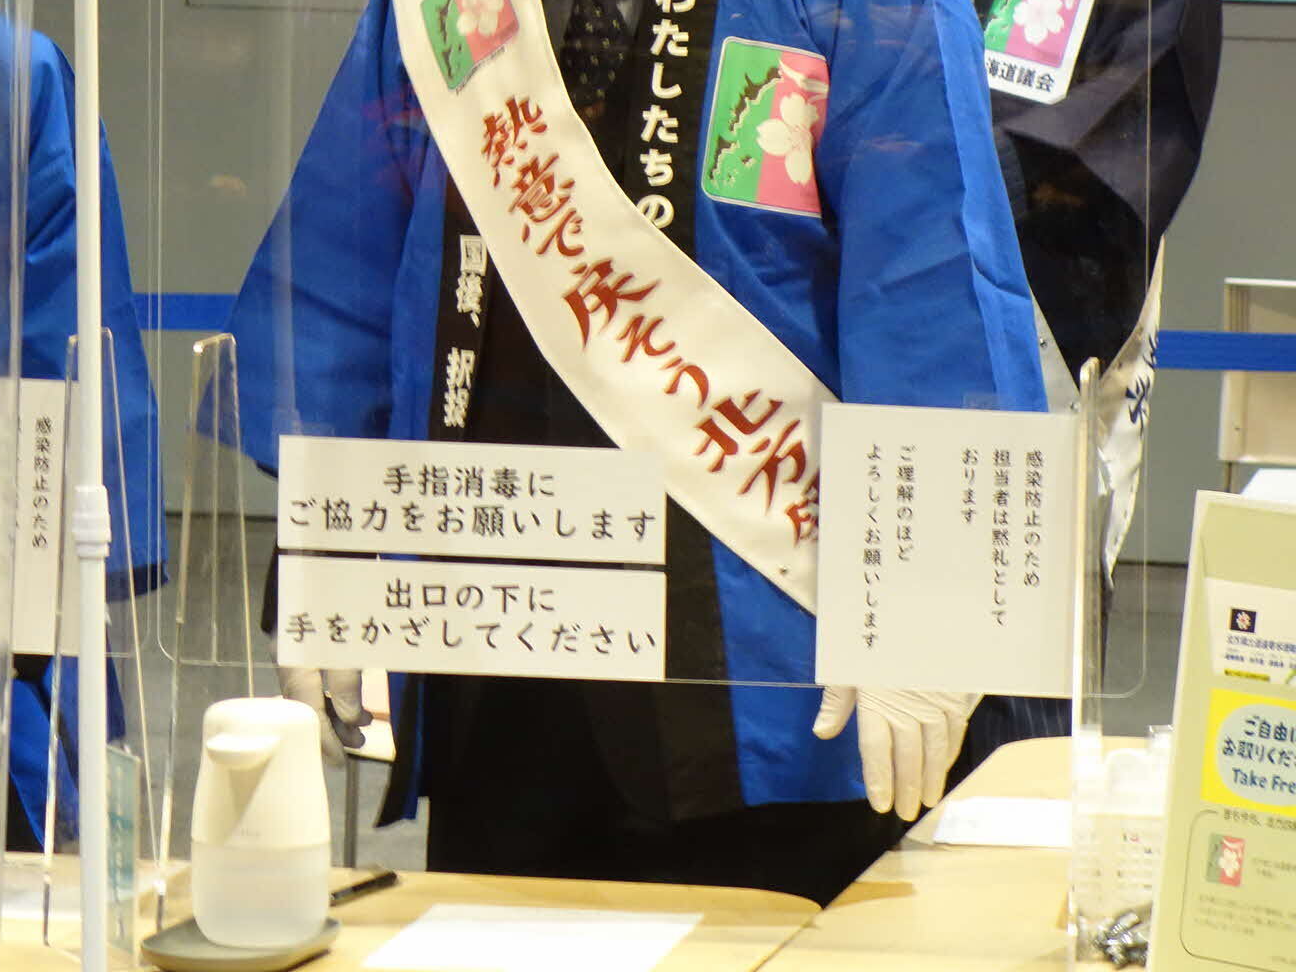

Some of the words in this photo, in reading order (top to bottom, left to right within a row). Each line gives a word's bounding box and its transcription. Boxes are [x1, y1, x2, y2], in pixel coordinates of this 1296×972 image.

[32, 415, 53, 550] 感染防止のため
[383, 463, 558, 499] 手指消毒に
[896, 444, 916, 563] ご理解のほど
[960, 448, 979, 526] おります
[289, 498, 657, 541] ご協力をお願いします
[862, 443, 883, 650] よろしくお願いします
[991, 449, 1012, 627] 担当者は黙礼として
[1024, 448, 1046, 589] 感染防止のため
[385, 577, 558, 614] 出口の下に
[285, 612, 658, 656] 手をかざしてください
[1222, 734, 1296, 769] お取りくだ
[1231, 766, 1268, 789] Take
